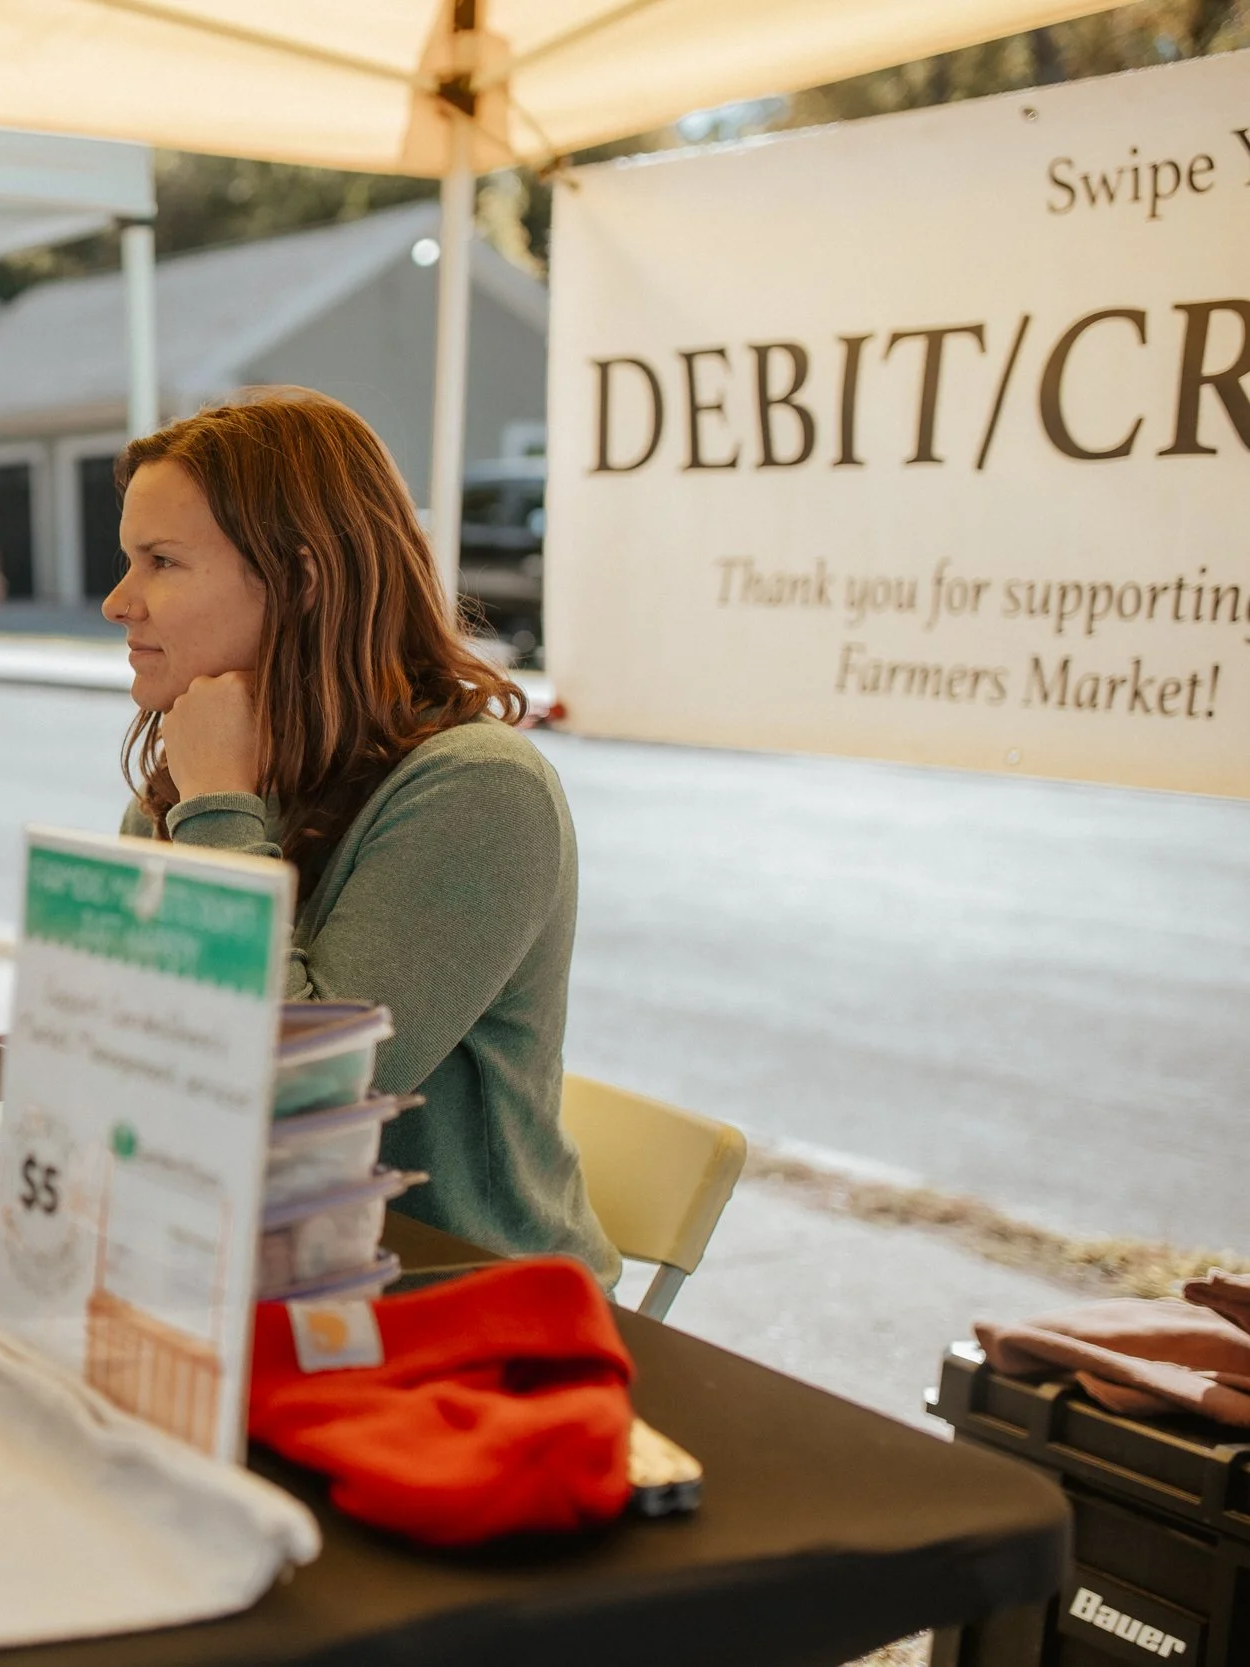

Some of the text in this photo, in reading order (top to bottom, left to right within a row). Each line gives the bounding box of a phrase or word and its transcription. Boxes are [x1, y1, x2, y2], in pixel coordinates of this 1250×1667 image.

[1047, 145, 1215, 222] Swipe
[588, 297, 1250, 476] DEBIT/CR
[714, 555, 1250, 645] Thank you for supportin
[834, 642, 1221, 718] Farmers Market!
[1068, 1587, 1187, 1658] Bauer
